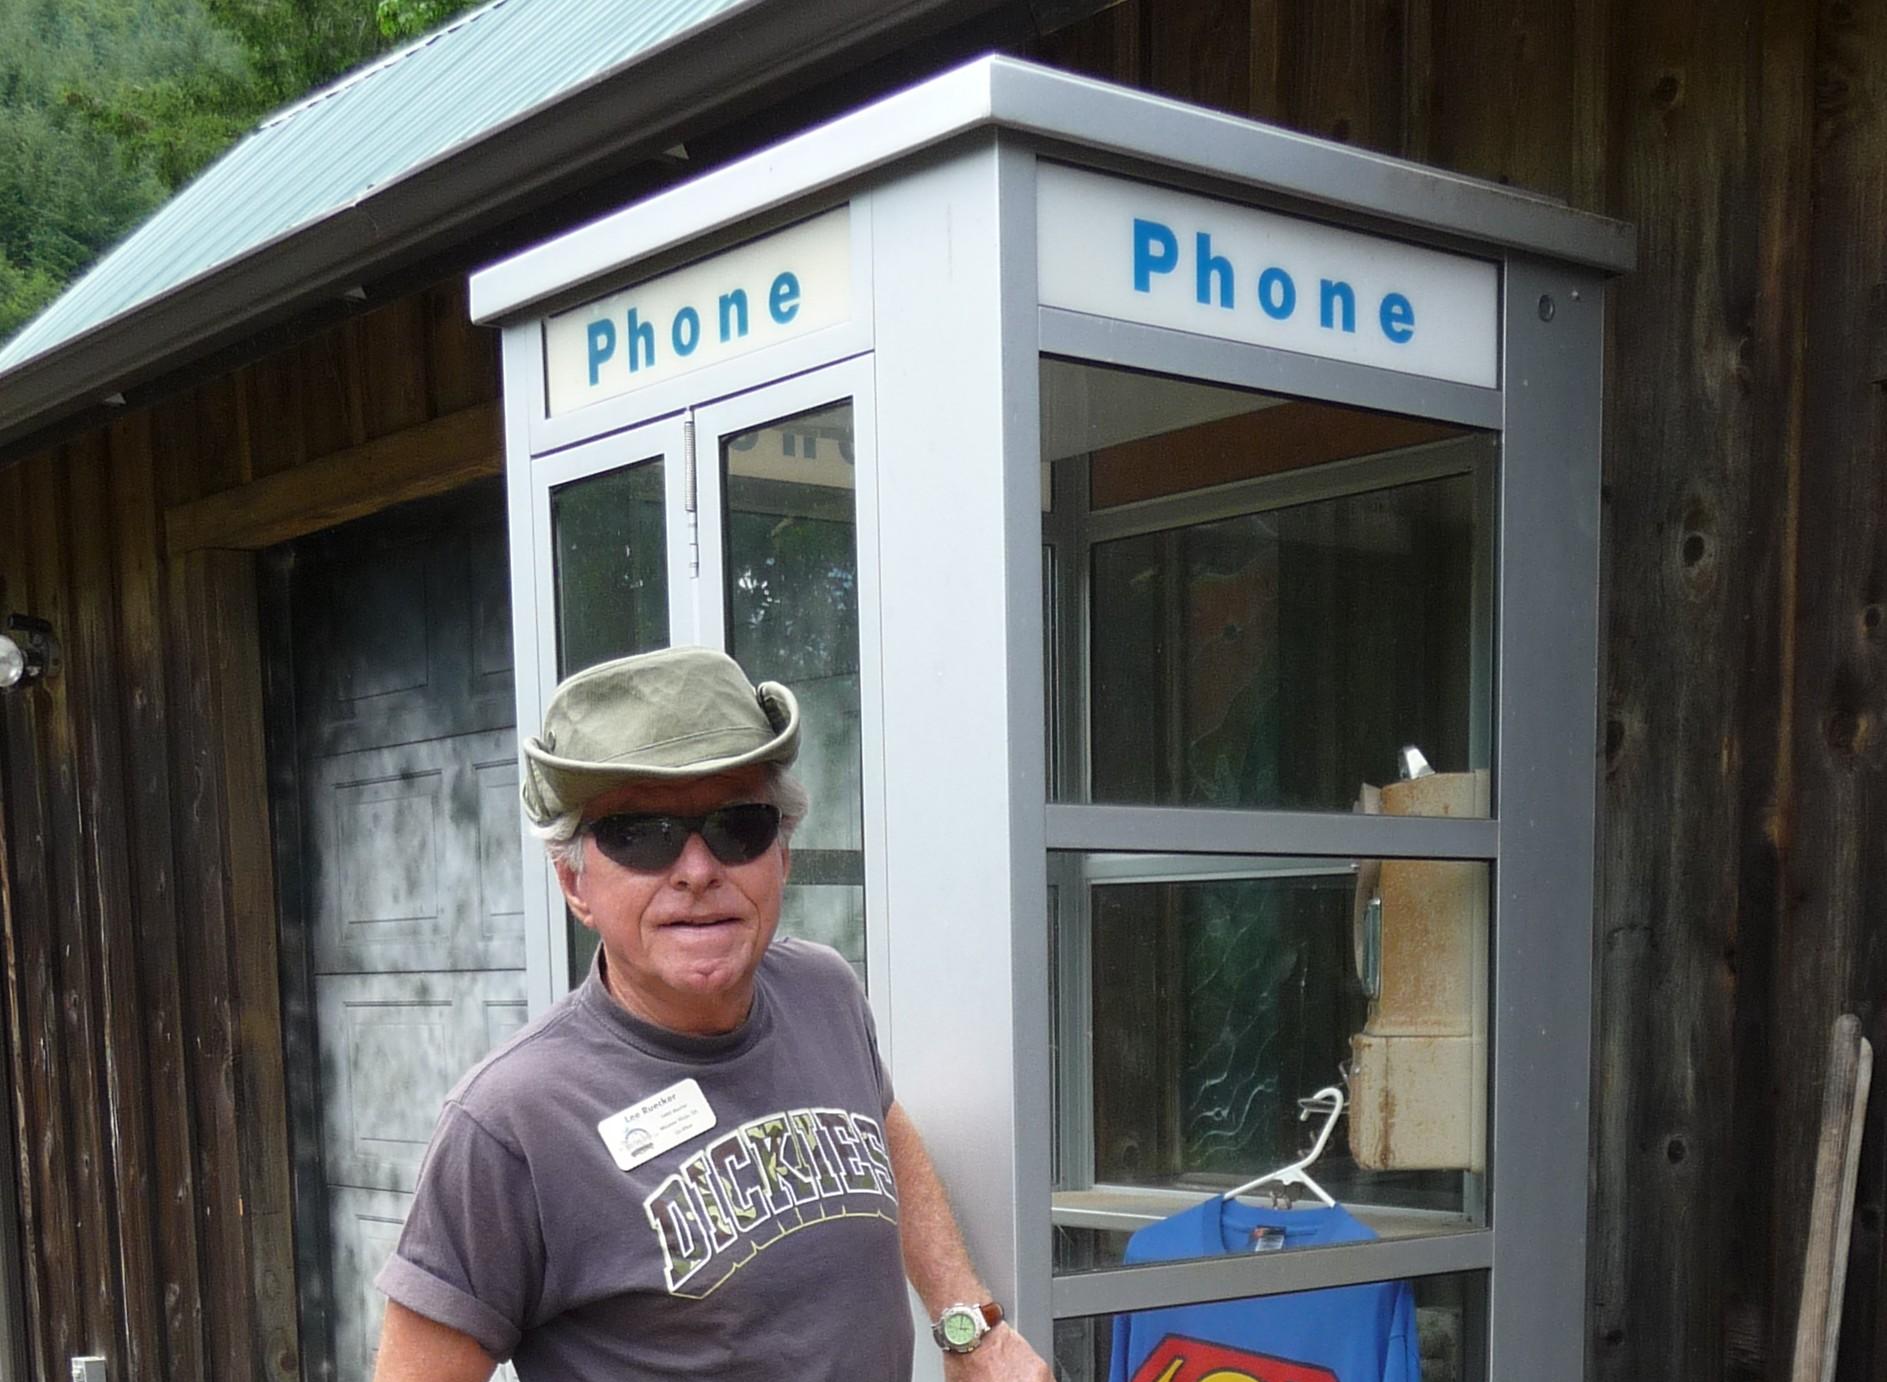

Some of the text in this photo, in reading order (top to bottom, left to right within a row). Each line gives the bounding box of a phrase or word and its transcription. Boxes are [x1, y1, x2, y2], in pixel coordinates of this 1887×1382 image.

[586, 271, 801, 387] Phone
[1133, 218, 1416, 345] Phone
[644, 1108, 898, 1292] DICKIES
